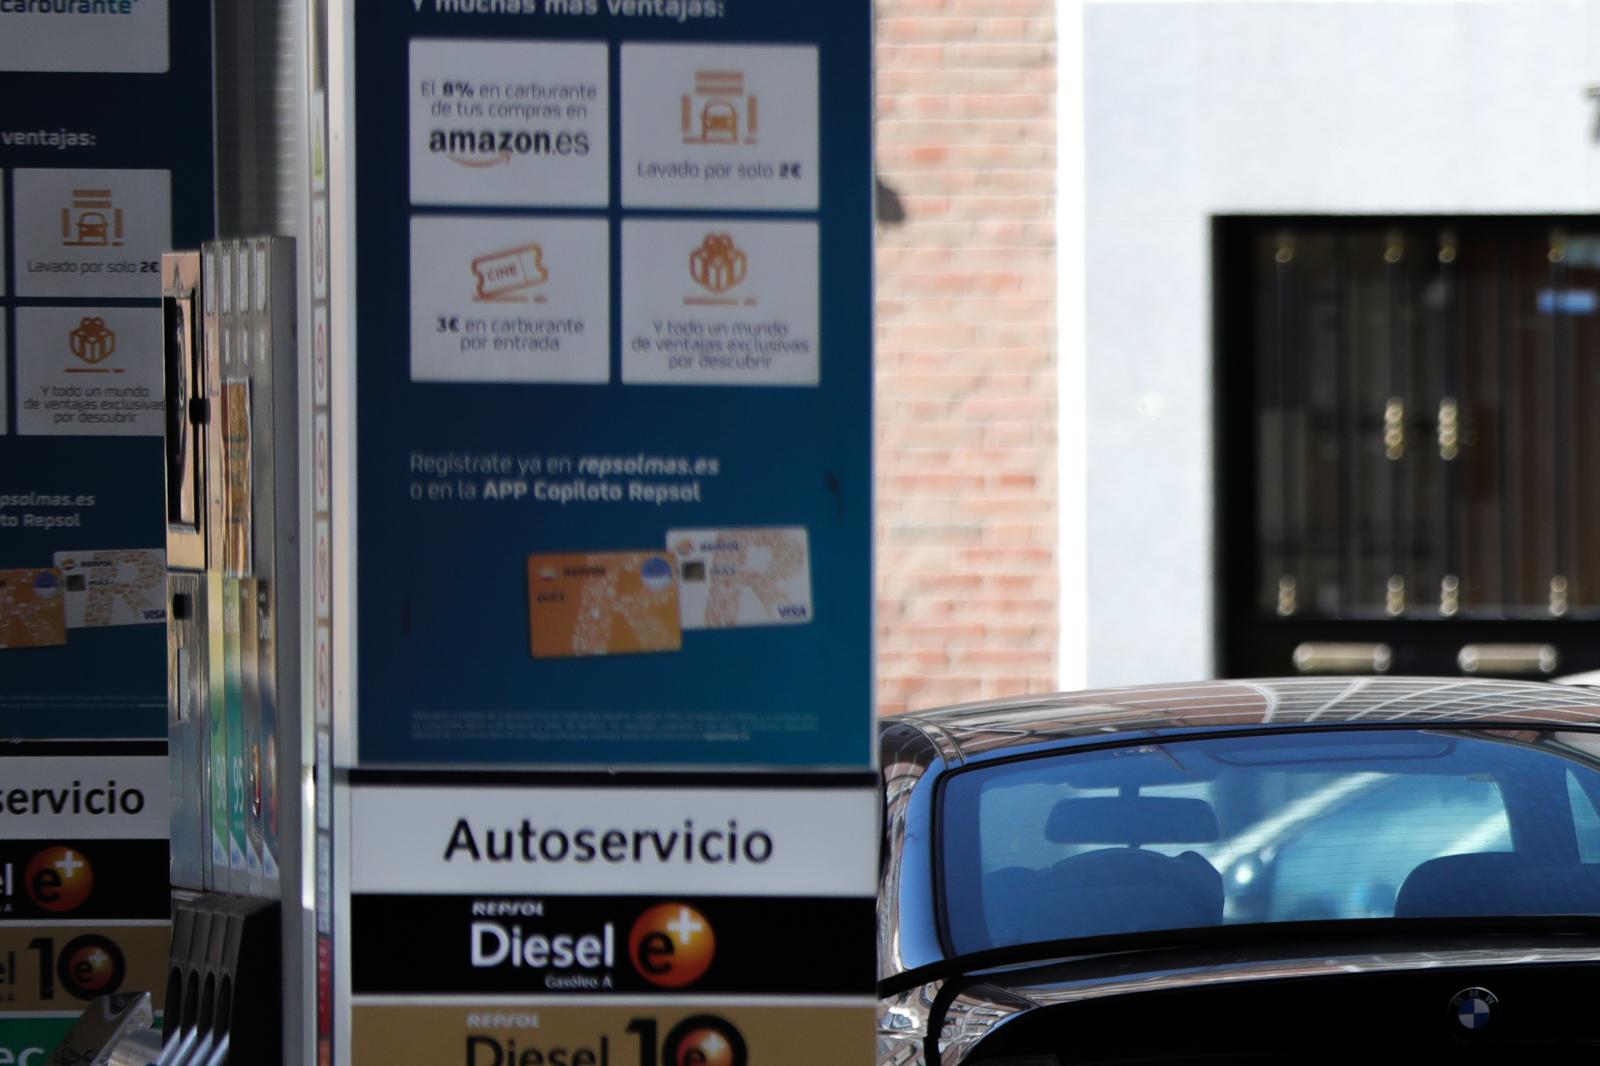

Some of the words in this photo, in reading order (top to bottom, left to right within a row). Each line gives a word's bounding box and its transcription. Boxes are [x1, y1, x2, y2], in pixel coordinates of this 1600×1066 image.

[435, 0, 536, 14] muchas
[606, 0, 726, 22] ventajas:
[421, 82, 436, 98] El
[442, 82, 474, 99] 8%
[479, 86, 500, 99] en
[504, 82, 597, 100] carburante
[431, 102, 451, 117] de
[456, 103, 484, 118] tus
[487, 104, 562, 122] compras
[566, 105, 587, 119] en
[1, 129, 96, 149] ventajas:
[429, 128, 590, 156] amazon.es
[637, 162, 699, 178] Lavado
[704, 165, 733, 181] por
[738, 163, 774, 179] solo
[778, 163, 803, 178] 2€
[27, 260, 78, 273] Lavado
[80, 263, 103, 276] por
[107, 260, 136, 273] solo
[140, 261, 160, 273] 2€
[486, 264, 518, 282] CINE
[436, 317, 460, 333] 3€
[465, 320, 487, 333] en
[491, 317, 584, 335] carburante
[653, 321, 663, 334] Y
[667, 321, 701, 335] todo
[706, 323, 727, 335] un
[731, 321, 787, 335] mundo
[460, 338, 489, 354] por
[493, 335, 560, 352] entrada
[631, 338, 652, 352] de
[655, 338, 723, 355] ventajas
[727, 338, 809, 353] exclusivas
[668, 356, 695, 372] por
[699, 354, 772, 370] descubrir
[52, 386, 81, 397] todo
[85, 388, 100, 397] un
[104, 386, 148, 397] mundo
[24, 400, 40, 410] de
[42, 399, 97, 411] ventajas
[101, 399, 164, 411] exclusivas
[54, 413, 74, 424] por
[78, 411, 137, 423] descubrir
[517, 458, 541, 479] ya
[547, 459, 571, 474] en
[578, 454, 719, 479] repsolmas.es
[410, 486, 422, 500] o
[428, 486, 453, 500] en
[458, 482, 476, 500] la
[483, 483, 527, 500] APP
[534, 482, 622, 504] Copiloto
[629, 482, 701, 505] Repsol
[22, 513, 82, 530] Repsol
[443, 818, 774, 863] Autoservicio
[472, 902, 545, 917] REPSOL
[471, 921, 615, 968] Diesel
[601, 976, 612, 989] A
[467, 1013, 539, 1029] REPSOL
